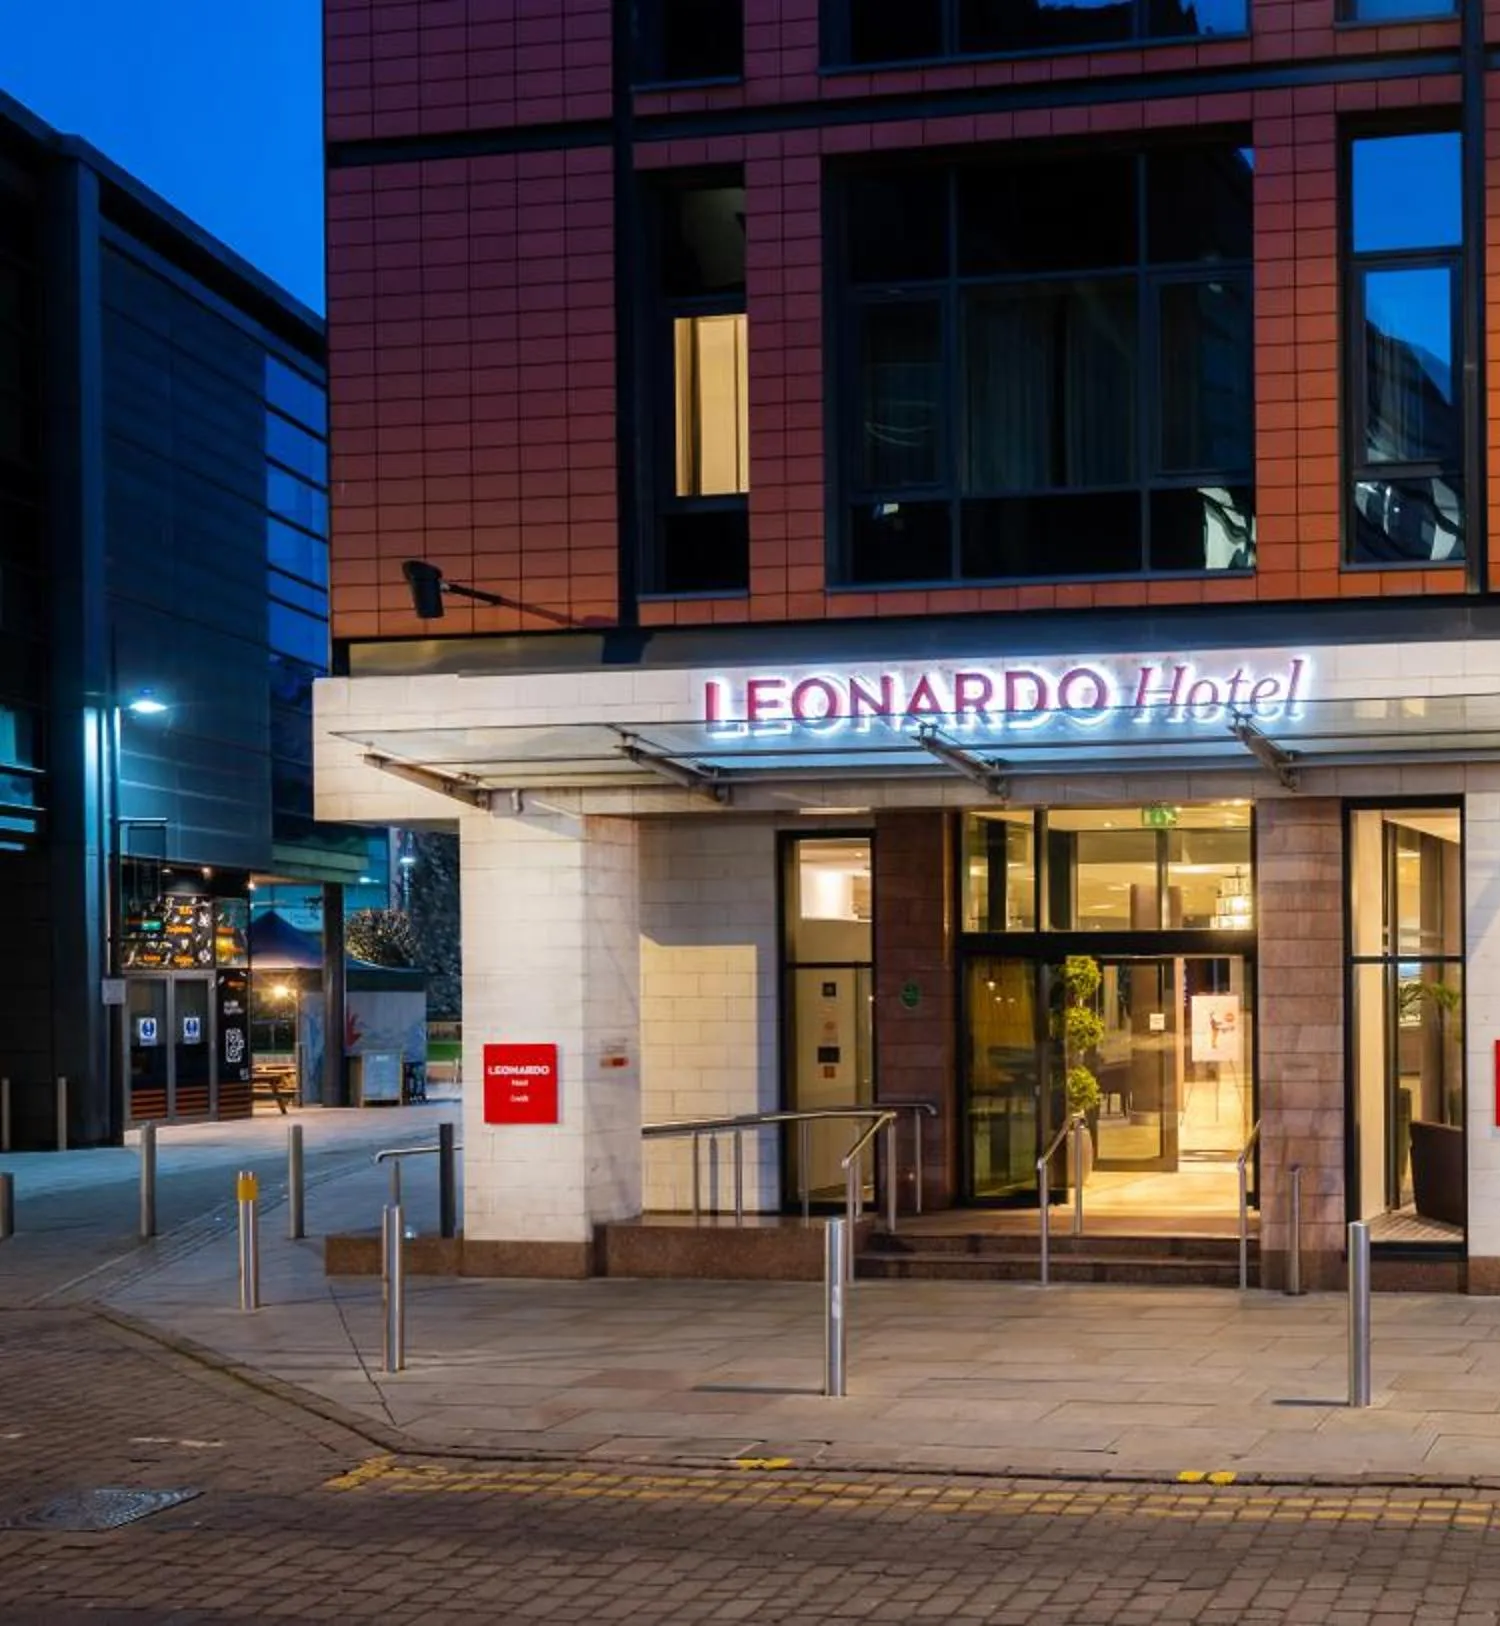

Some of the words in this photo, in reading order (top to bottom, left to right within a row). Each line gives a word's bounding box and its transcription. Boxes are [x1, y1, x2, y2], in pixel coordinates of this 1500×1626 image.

[705, 667, 1112, 735] LEONARDO
[1133, 658, 1309, 724] Hotel
[488, 1065, 550, 1075] LEONARDO
